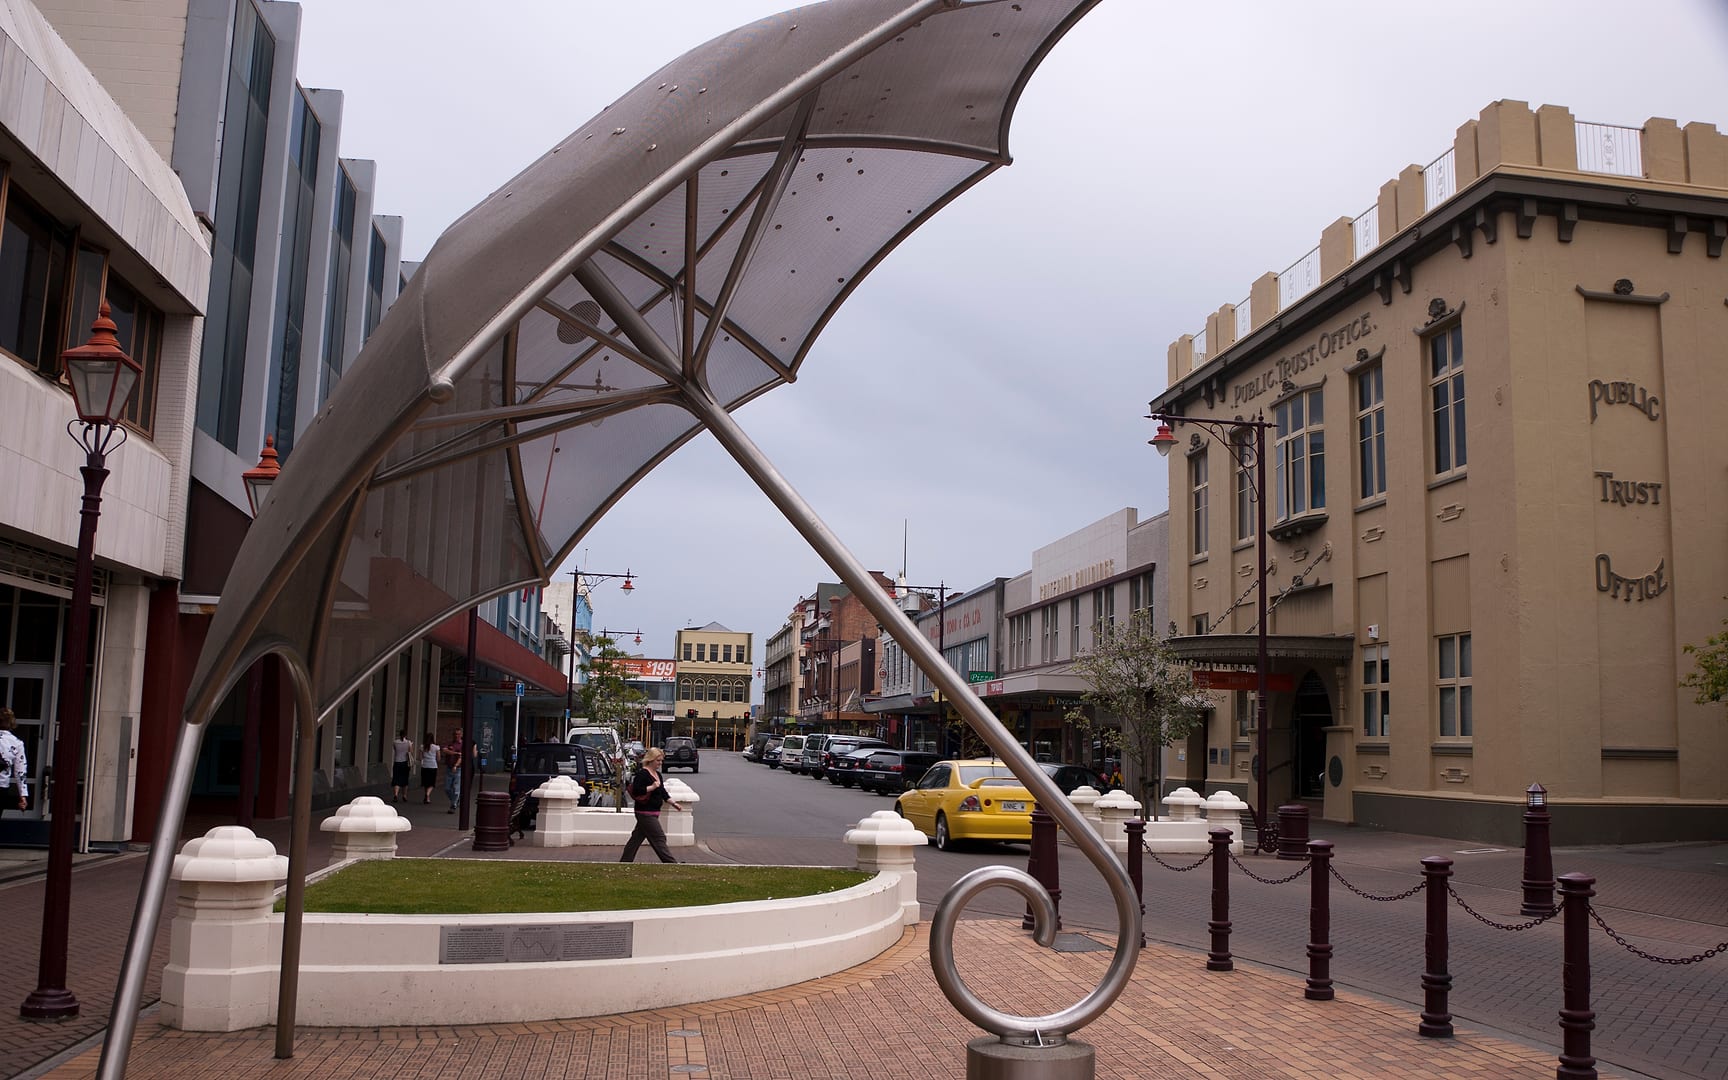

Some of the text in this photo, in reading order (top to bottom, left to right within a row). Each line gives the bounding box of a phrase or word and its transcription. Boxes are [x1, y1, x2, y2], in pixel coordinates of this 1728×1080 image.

[1588, 378, 1660, 425] PUBLIC
[1594, 470, 1663, 507] TRUST
[1595, 552, 1669, 603] OFFICE
[647, 661, 674, 675] $199
